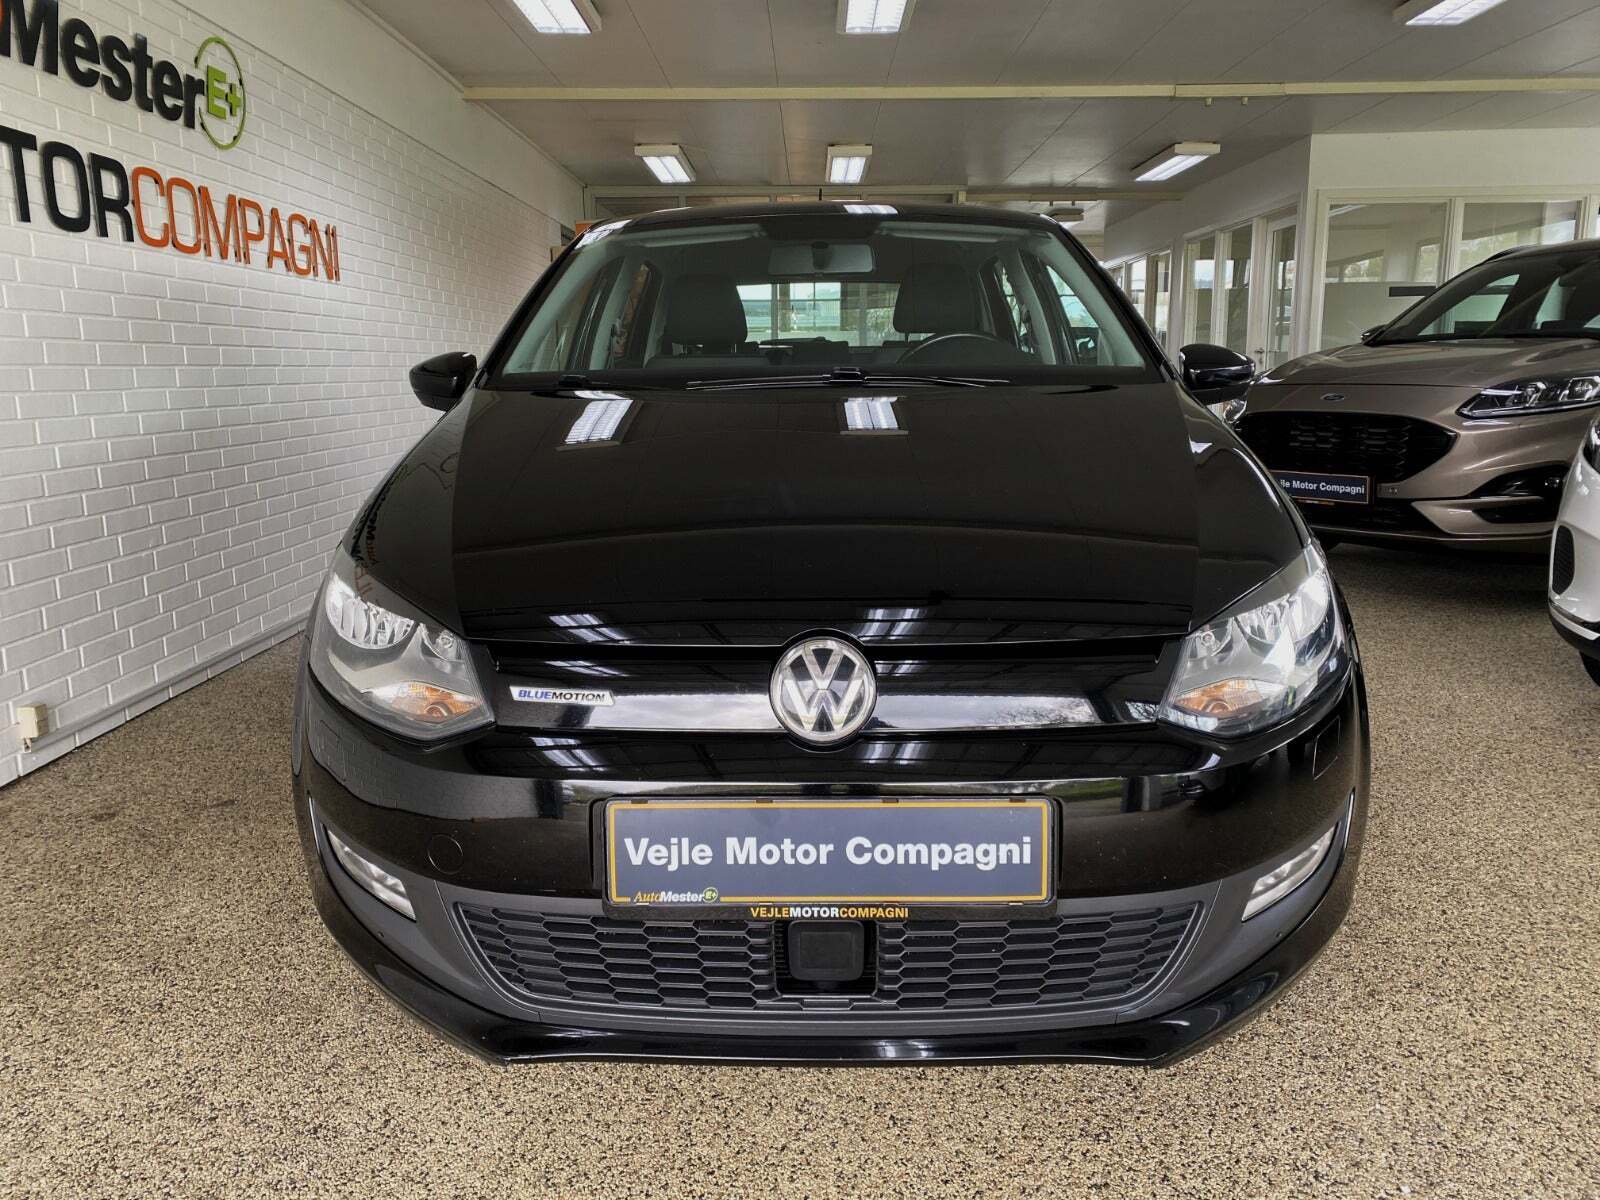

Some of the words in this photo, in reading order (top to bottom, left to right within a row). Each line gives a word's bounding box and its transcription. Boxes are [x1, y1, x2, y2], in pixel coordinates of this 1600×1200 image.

[0, 0, 204, 129] Mester
[0, 124, 340, 281] TORCOMPAGNI
[1292, 480, 1317, 490] Motor
[1320, 482, 1365, 495] Compagni
[517, 689, 606, 701] BLUEMOTION
[624, 837, 713, 872] Vejle
[726, 836, 834, 865] Motor
[845, 836, 1032, 872] Compagni
[634, 890, 704, 903] AutoMester
[750, 906, 909, 919] VEJLEMOTORCOMPAGNI
